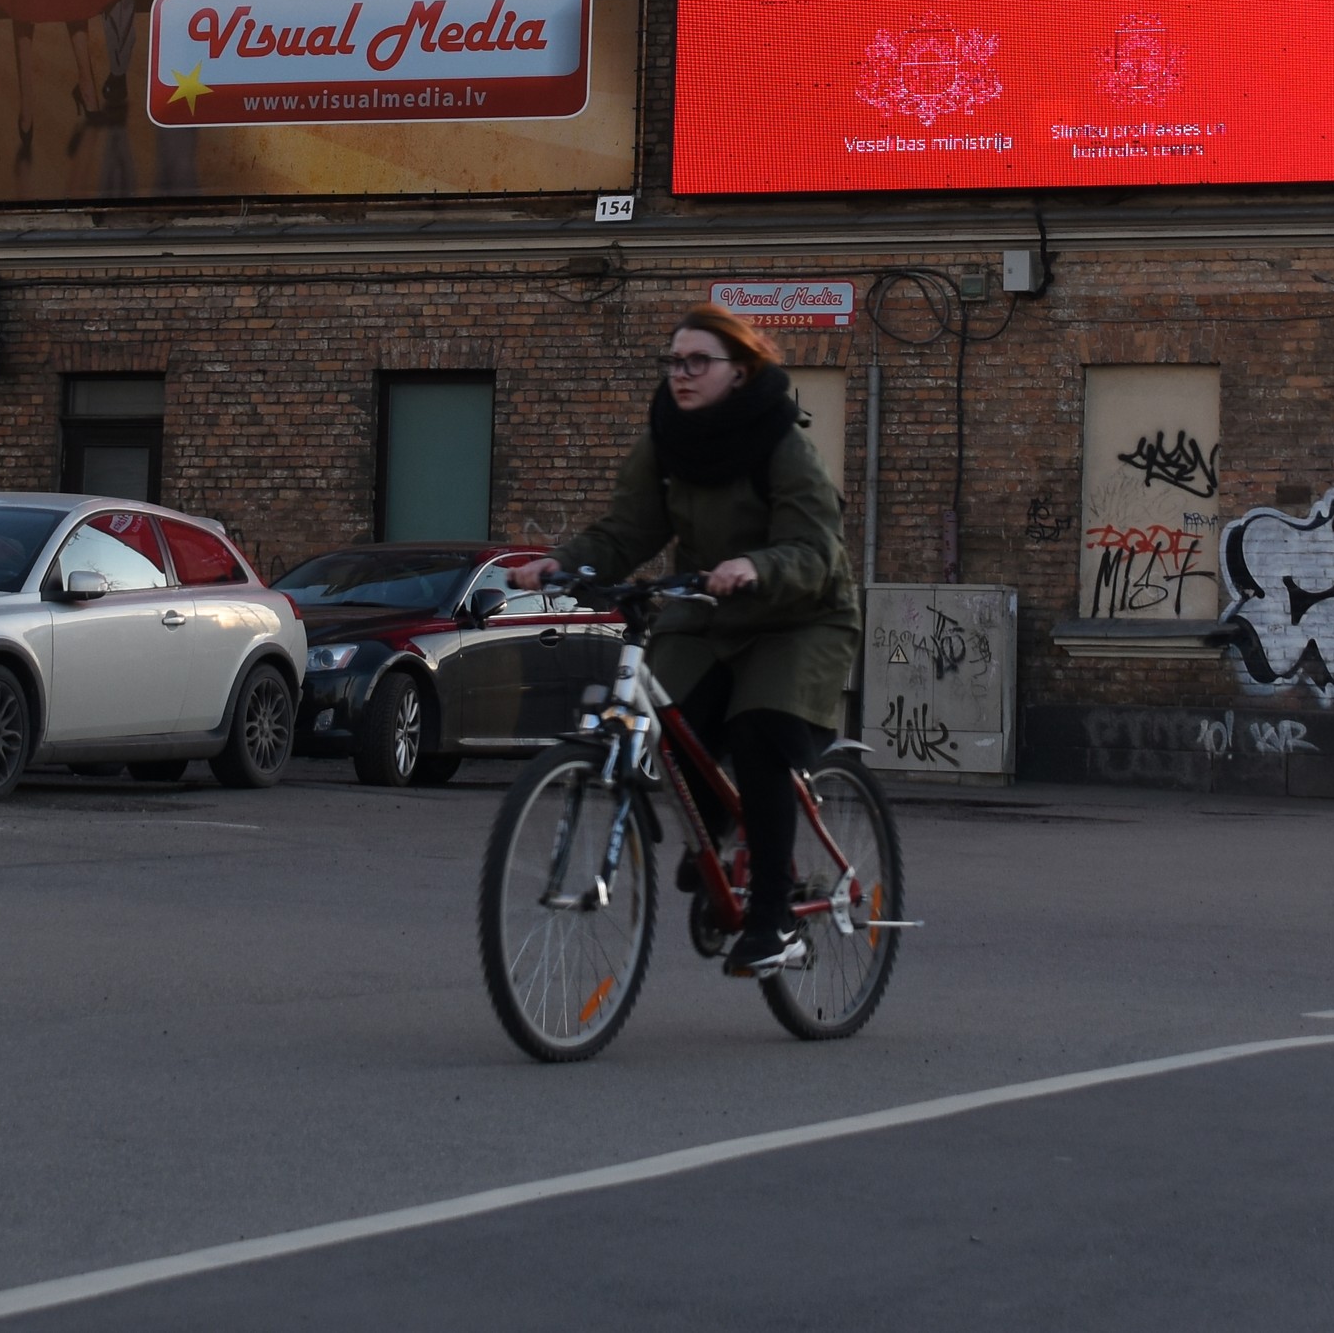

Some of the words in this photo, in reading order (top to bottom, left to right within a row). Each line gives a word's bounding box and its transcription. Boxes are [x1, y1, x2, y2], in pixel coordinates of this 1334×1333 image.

[188, 3, 362, 60] Visual
[367, 0, 548, 71] Media
[243, 88, 487, 112] www.visualmedia.lv
[931, 133, 1014, 153] ministrija
[600, 200, 631, 215] 154
[721, 287, 781, 307] Visual
[781, 287, 842, 311] Media
